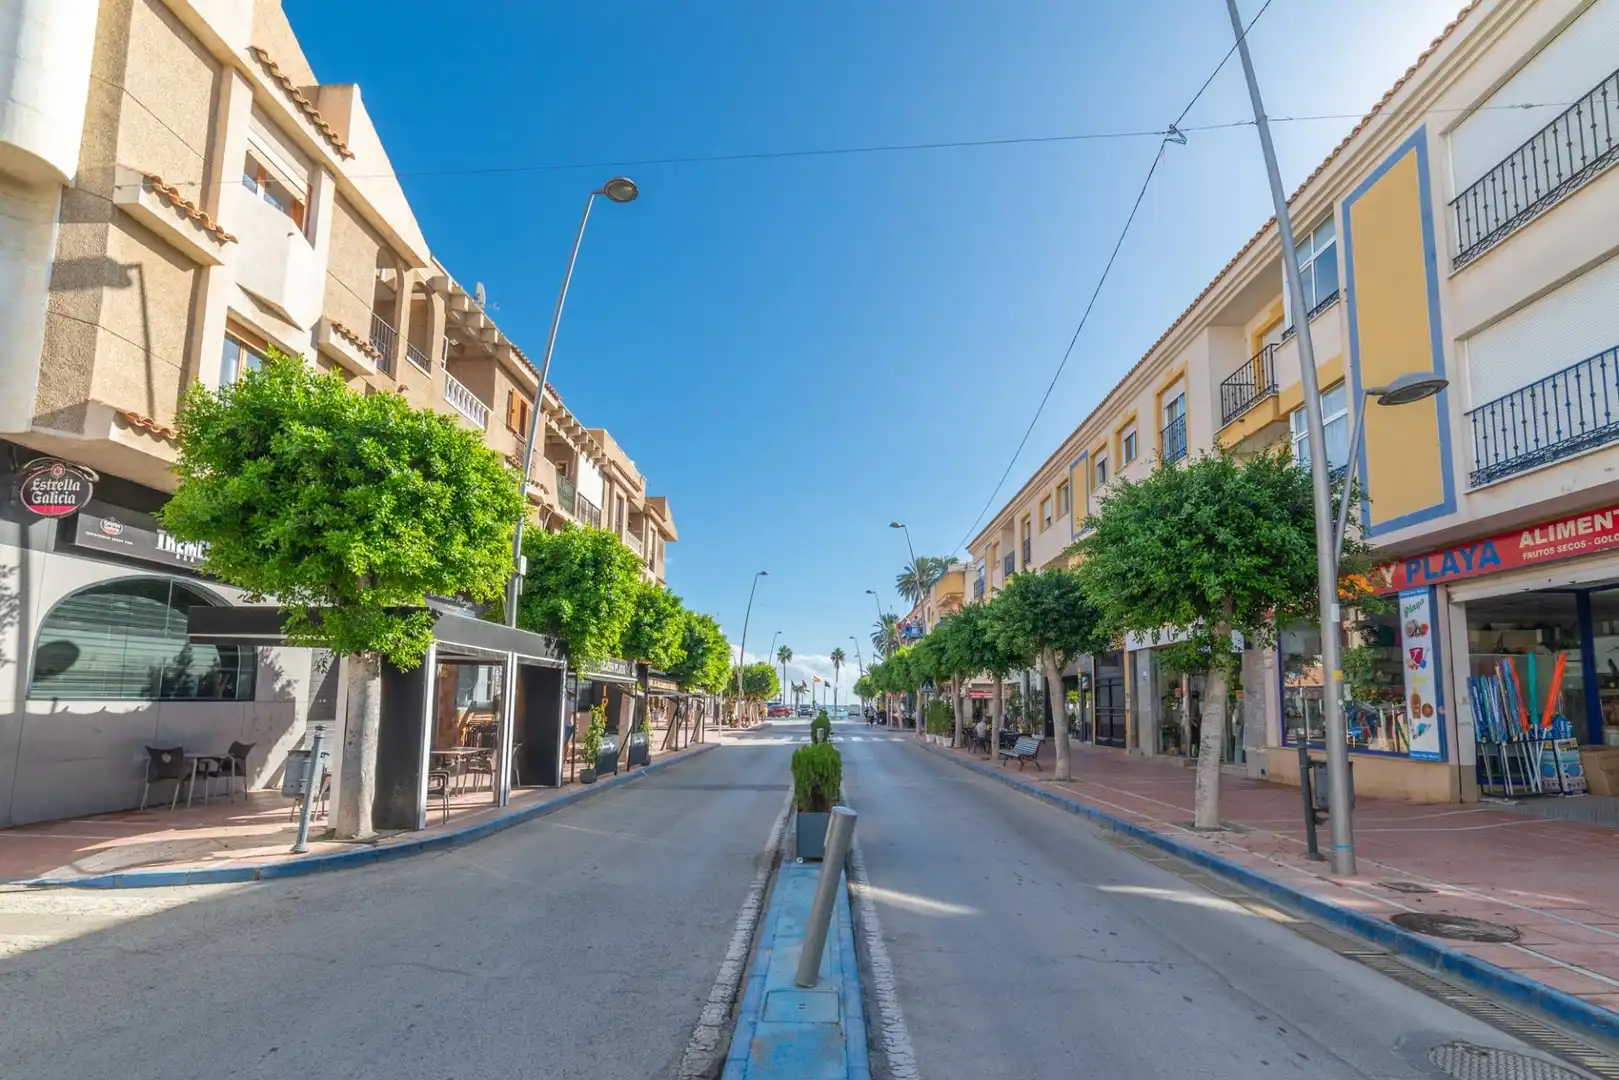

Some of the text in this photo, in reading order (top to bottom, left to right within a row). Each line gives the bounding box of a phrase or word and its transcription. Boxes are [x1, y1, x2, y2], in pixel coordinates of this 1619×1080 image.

[31, 478, 80, 491] Estrella
[31, 490, 75, 504] Galicia
[1523, 547, 1555, 560] FRUTOS
[1557, 540, 1586, 553] SECOS
[1406, 539, 1502, 584] PLAYA
